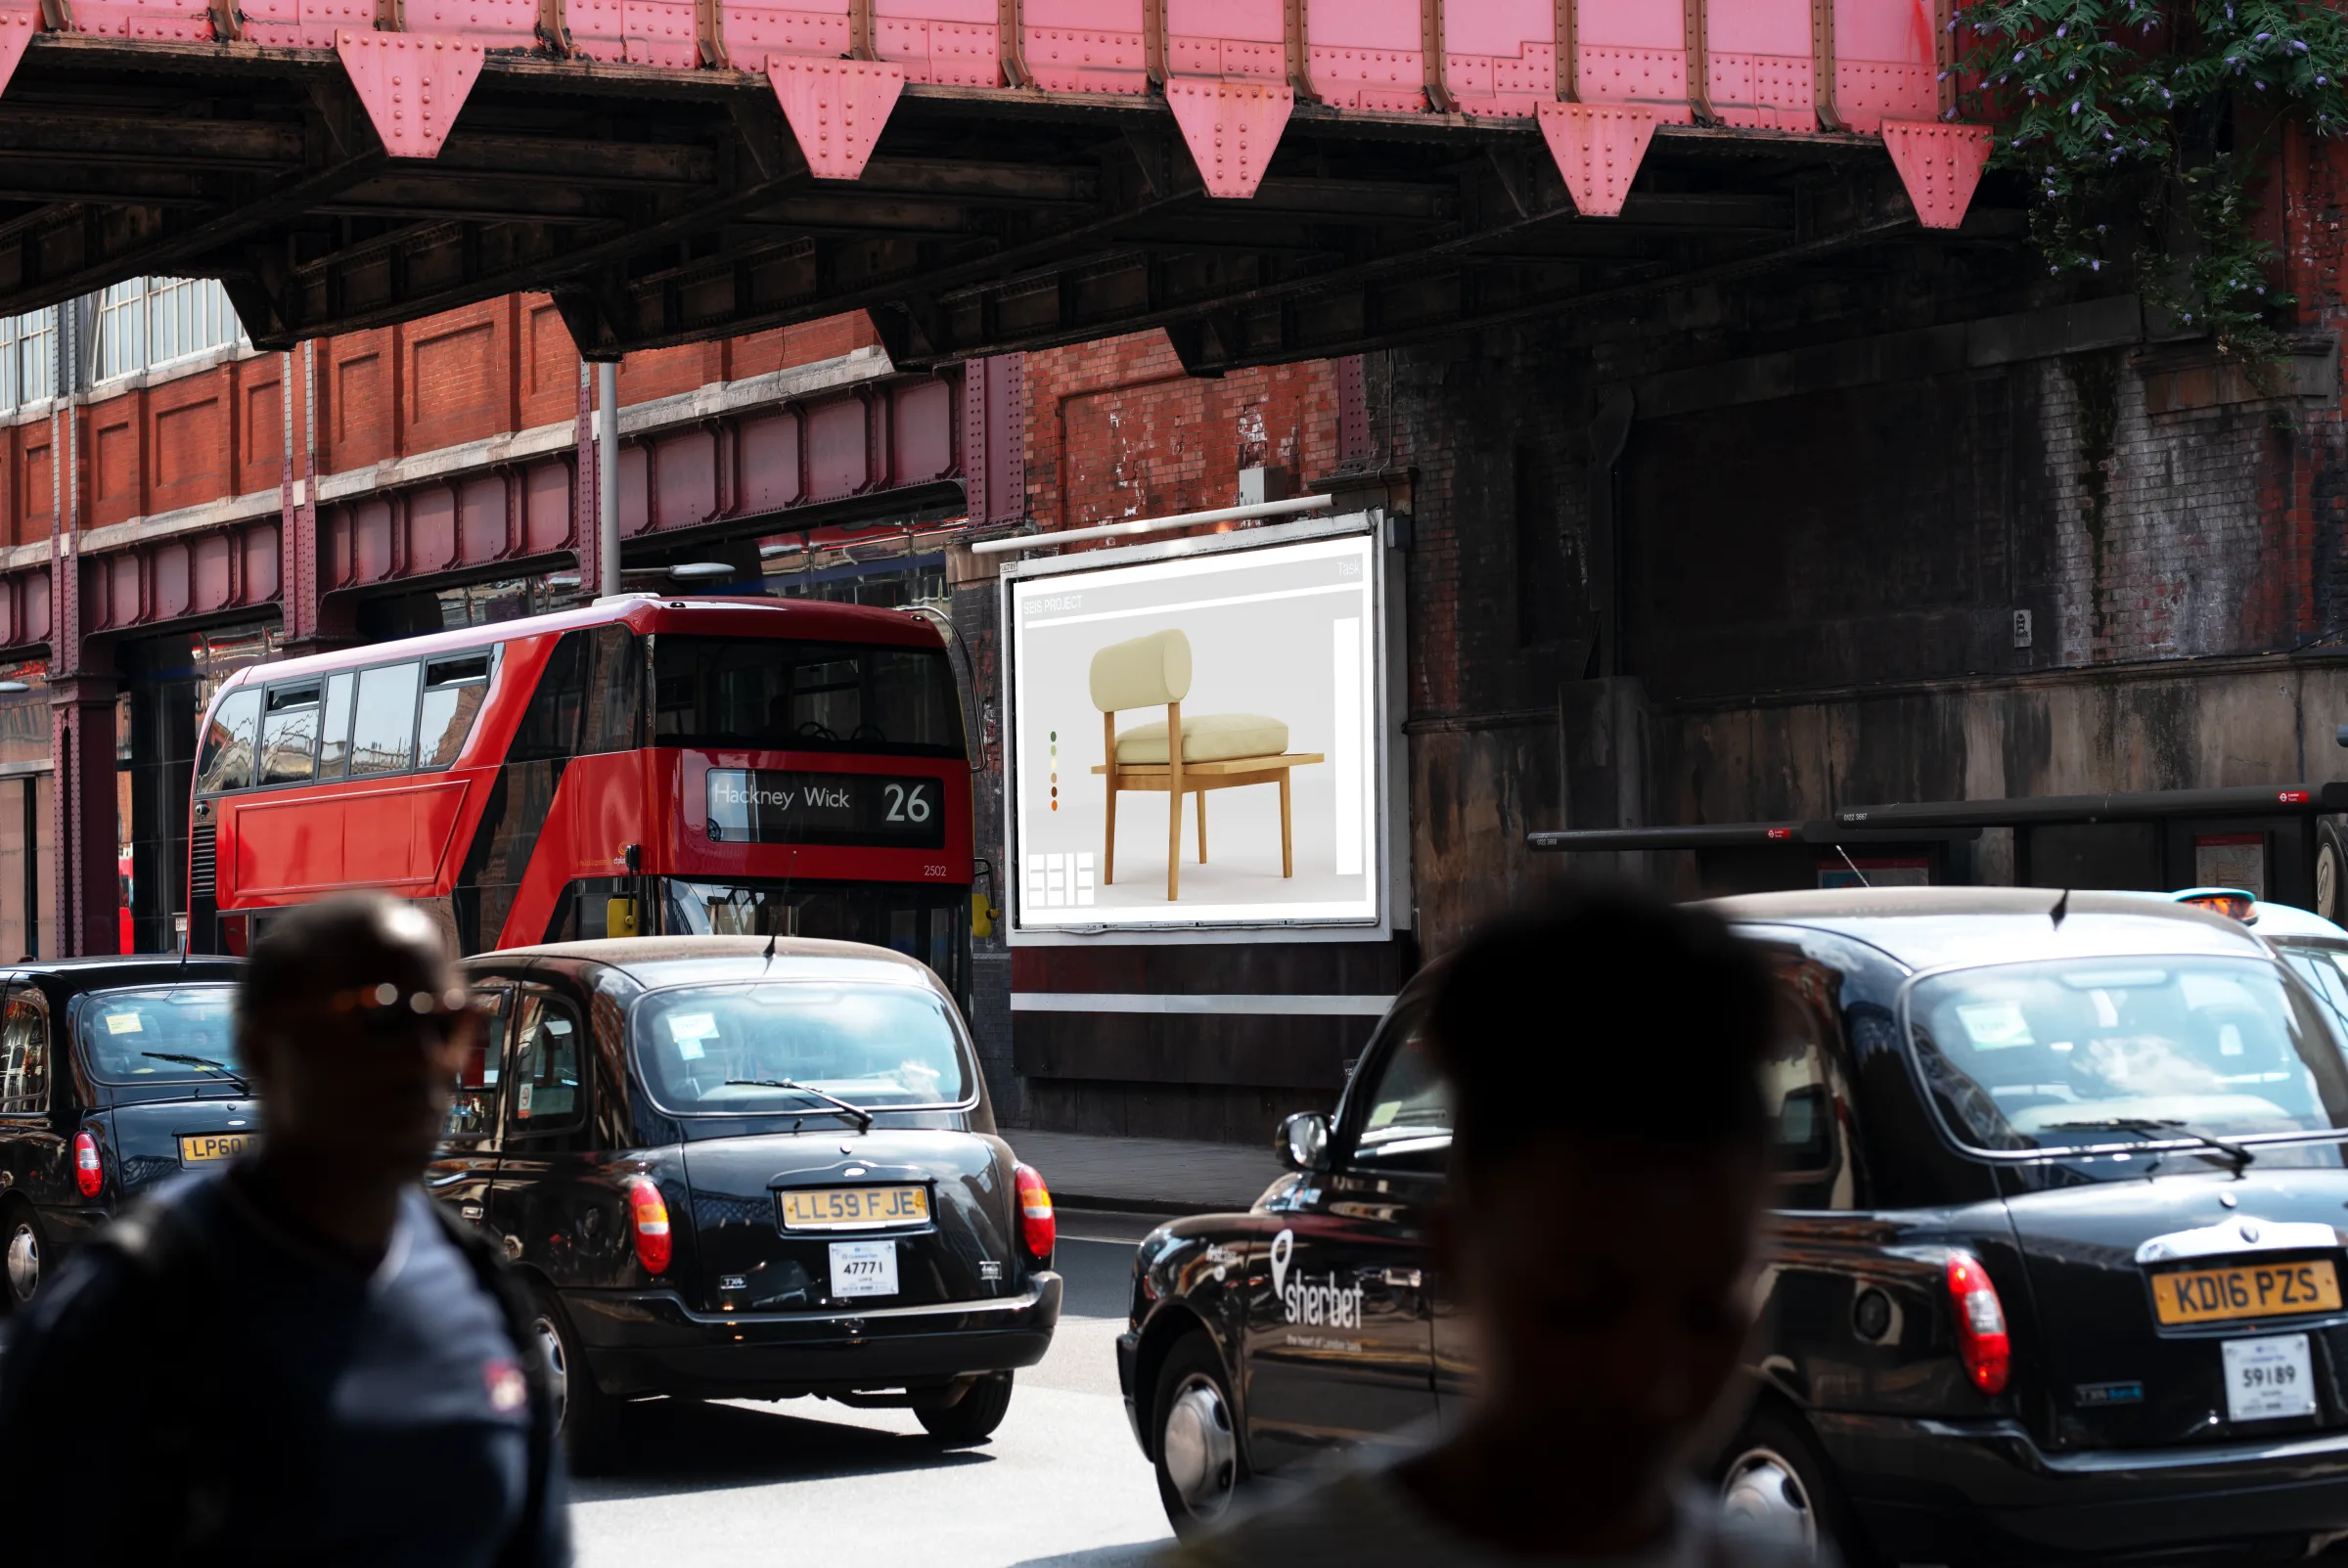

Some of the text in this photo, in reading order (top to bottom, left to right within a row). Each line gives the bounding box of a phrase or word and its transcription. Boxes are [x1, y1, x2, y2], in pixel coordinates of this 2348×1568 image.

[1336, 559, 1361, 577] Task
[1023, 595, 1082, 614] SEIS PROJECT
[714, 784, 850, 811] Hackney Wick
[884, 784, 929, 823] 26
[924, 865, 947, 876] 2502
[1027, 852, 1095, 907] SEIS
[192, 1138, 243, 1157] LP60
[793, 1191, 916, 1220] LL59 FJE
[843, 1261, 882, 1276] 47771
[1285, 1268, 1364, 1330] sherbet
[2174, 1268, 2319, 1314] KD16 PZS
[2243, 1365, 2296, 1388] 59189
